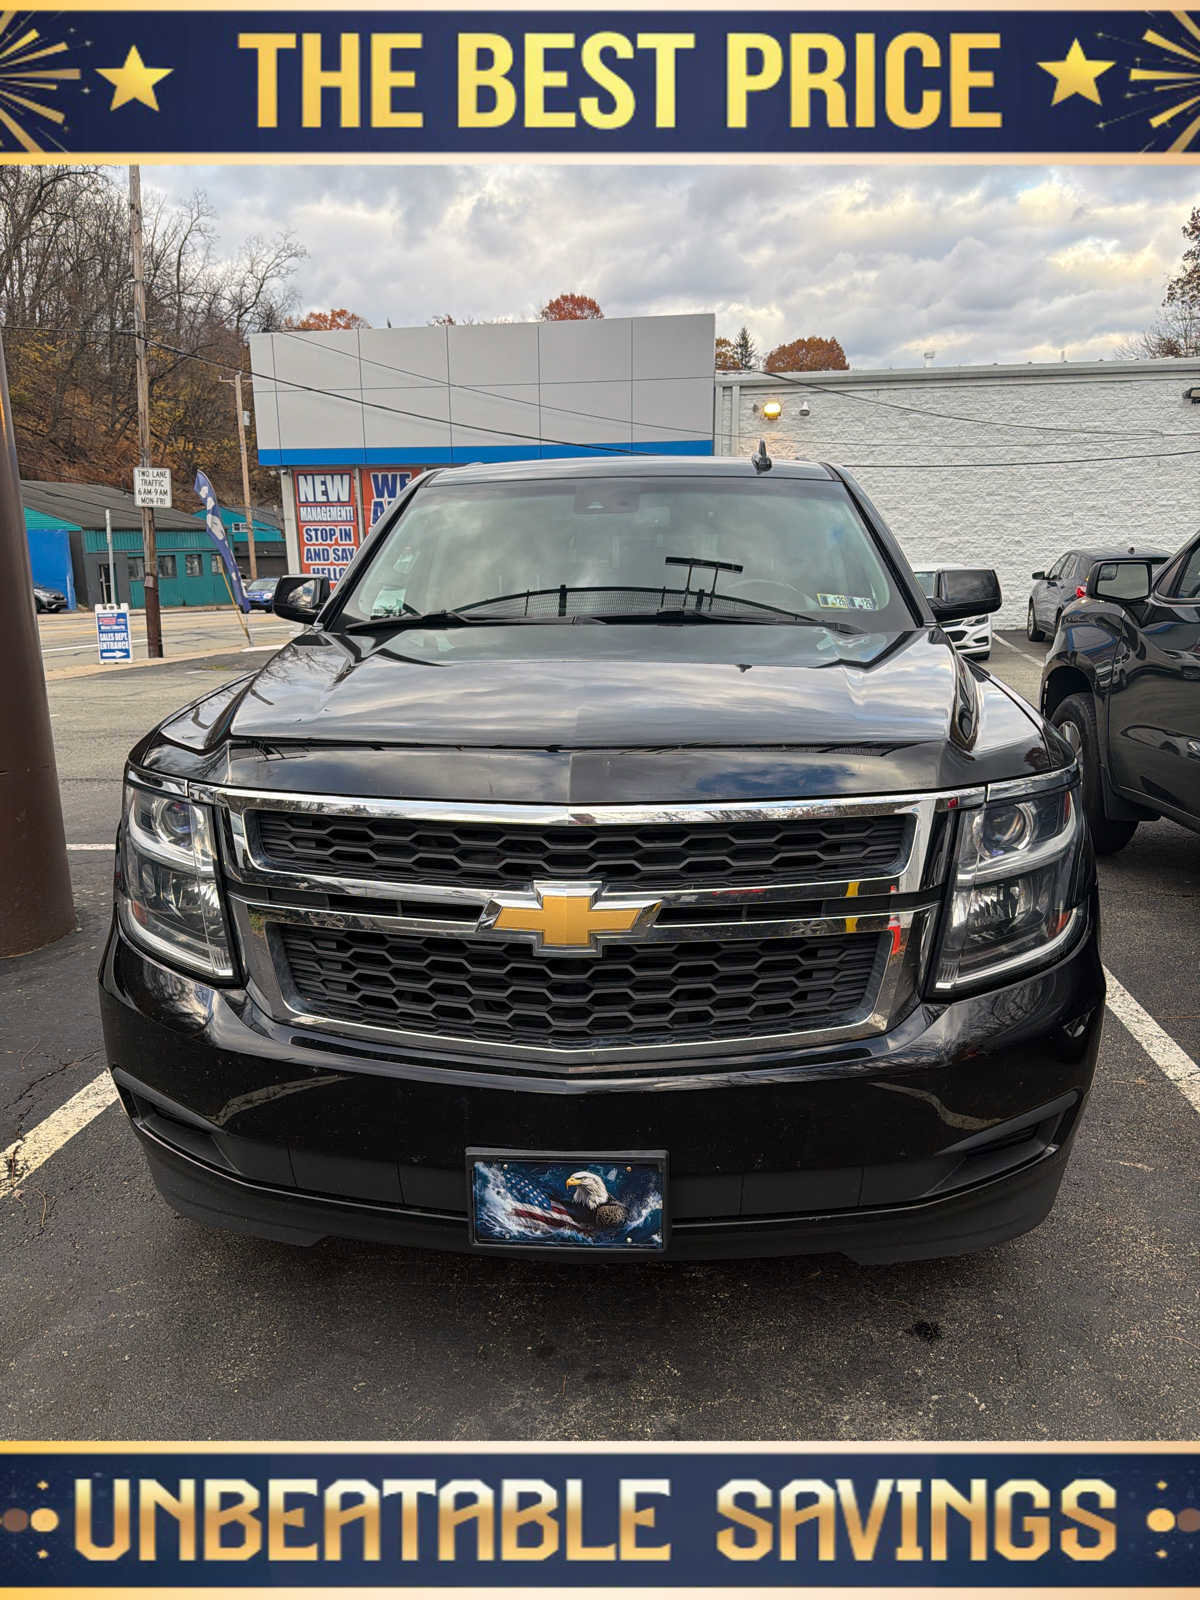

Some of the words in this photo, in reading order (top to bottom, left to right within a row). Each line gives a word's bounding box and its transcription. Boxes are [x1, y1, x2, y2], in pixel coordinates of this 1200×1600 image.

[137, 470, 149, 478] TWO
[141, 479, 164, 487] TRAFFIC
[297, 474, 351, 502] NEW
[300, 506, 354, 521] MANAGEMENT!
[305, 527, 336, 542] STOP
[339, 527, 353, 542] IN
[305, 547, 330, 562] AND
[332, 547, 355, 562] SAY
[101, 641, 129, 649] ENTRANCE
